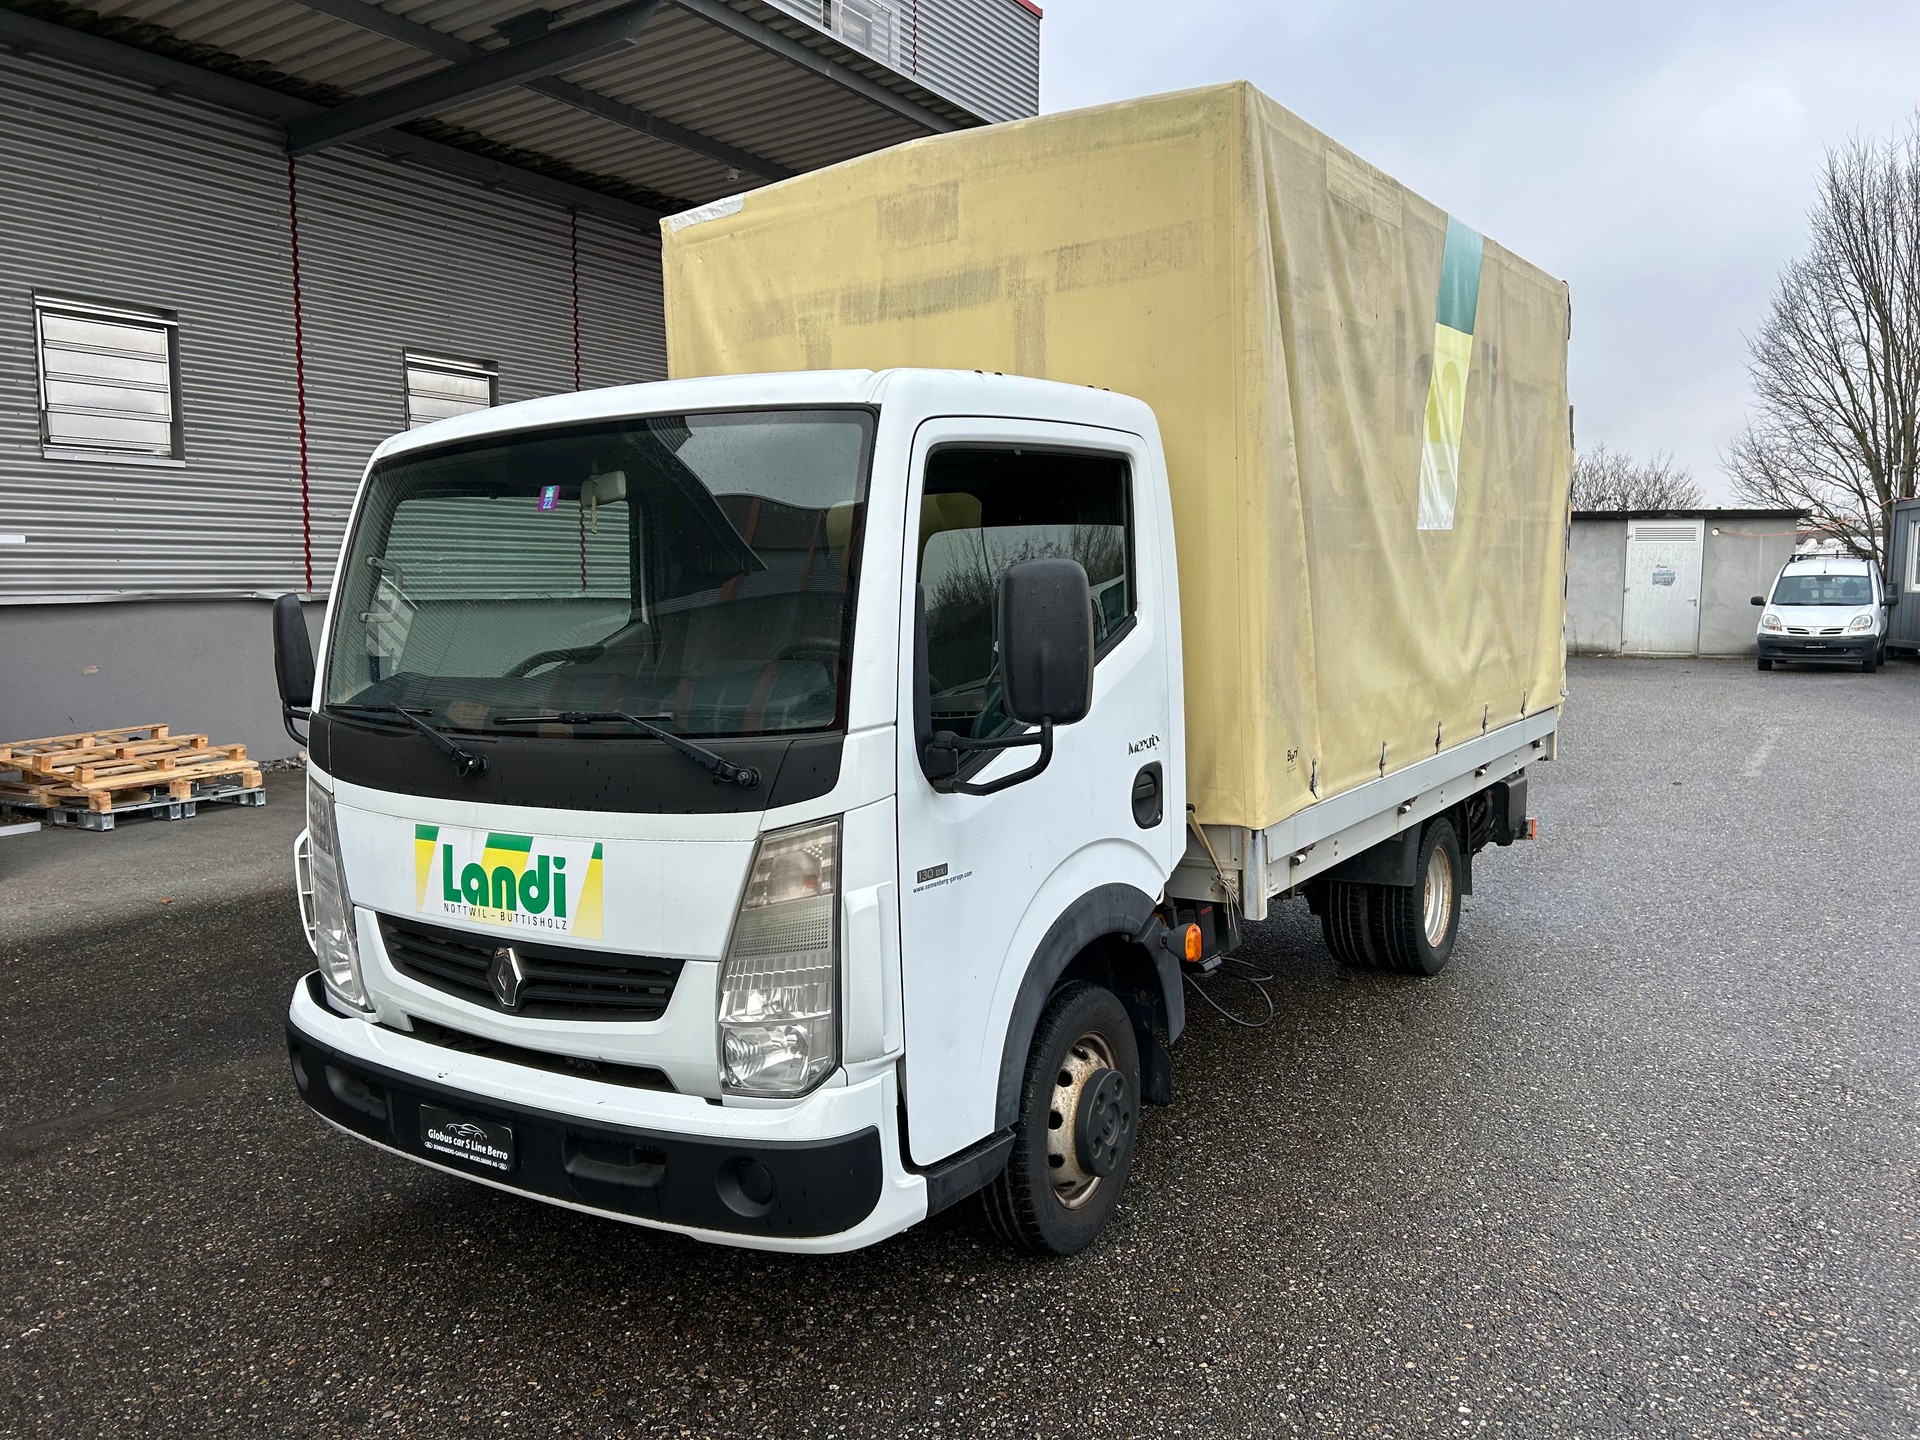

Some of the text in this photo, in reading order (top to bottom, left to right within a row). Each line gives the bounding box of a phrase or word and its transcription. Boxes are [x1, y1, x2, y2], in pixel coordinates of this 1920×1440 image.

[542, 497, 553, 509] 22
[443, 844, 567, 918] Landi
[913, 871, 973, 893] www.sonnenberg-garage.com
[918, 869, 934, 881] 130
[443, 902, 487, 919] NOTTWIL
[500, 911, 567, 930] BUTTISHOLZ
[428, 1128, 508, 1160] Globus car S Line Berro
